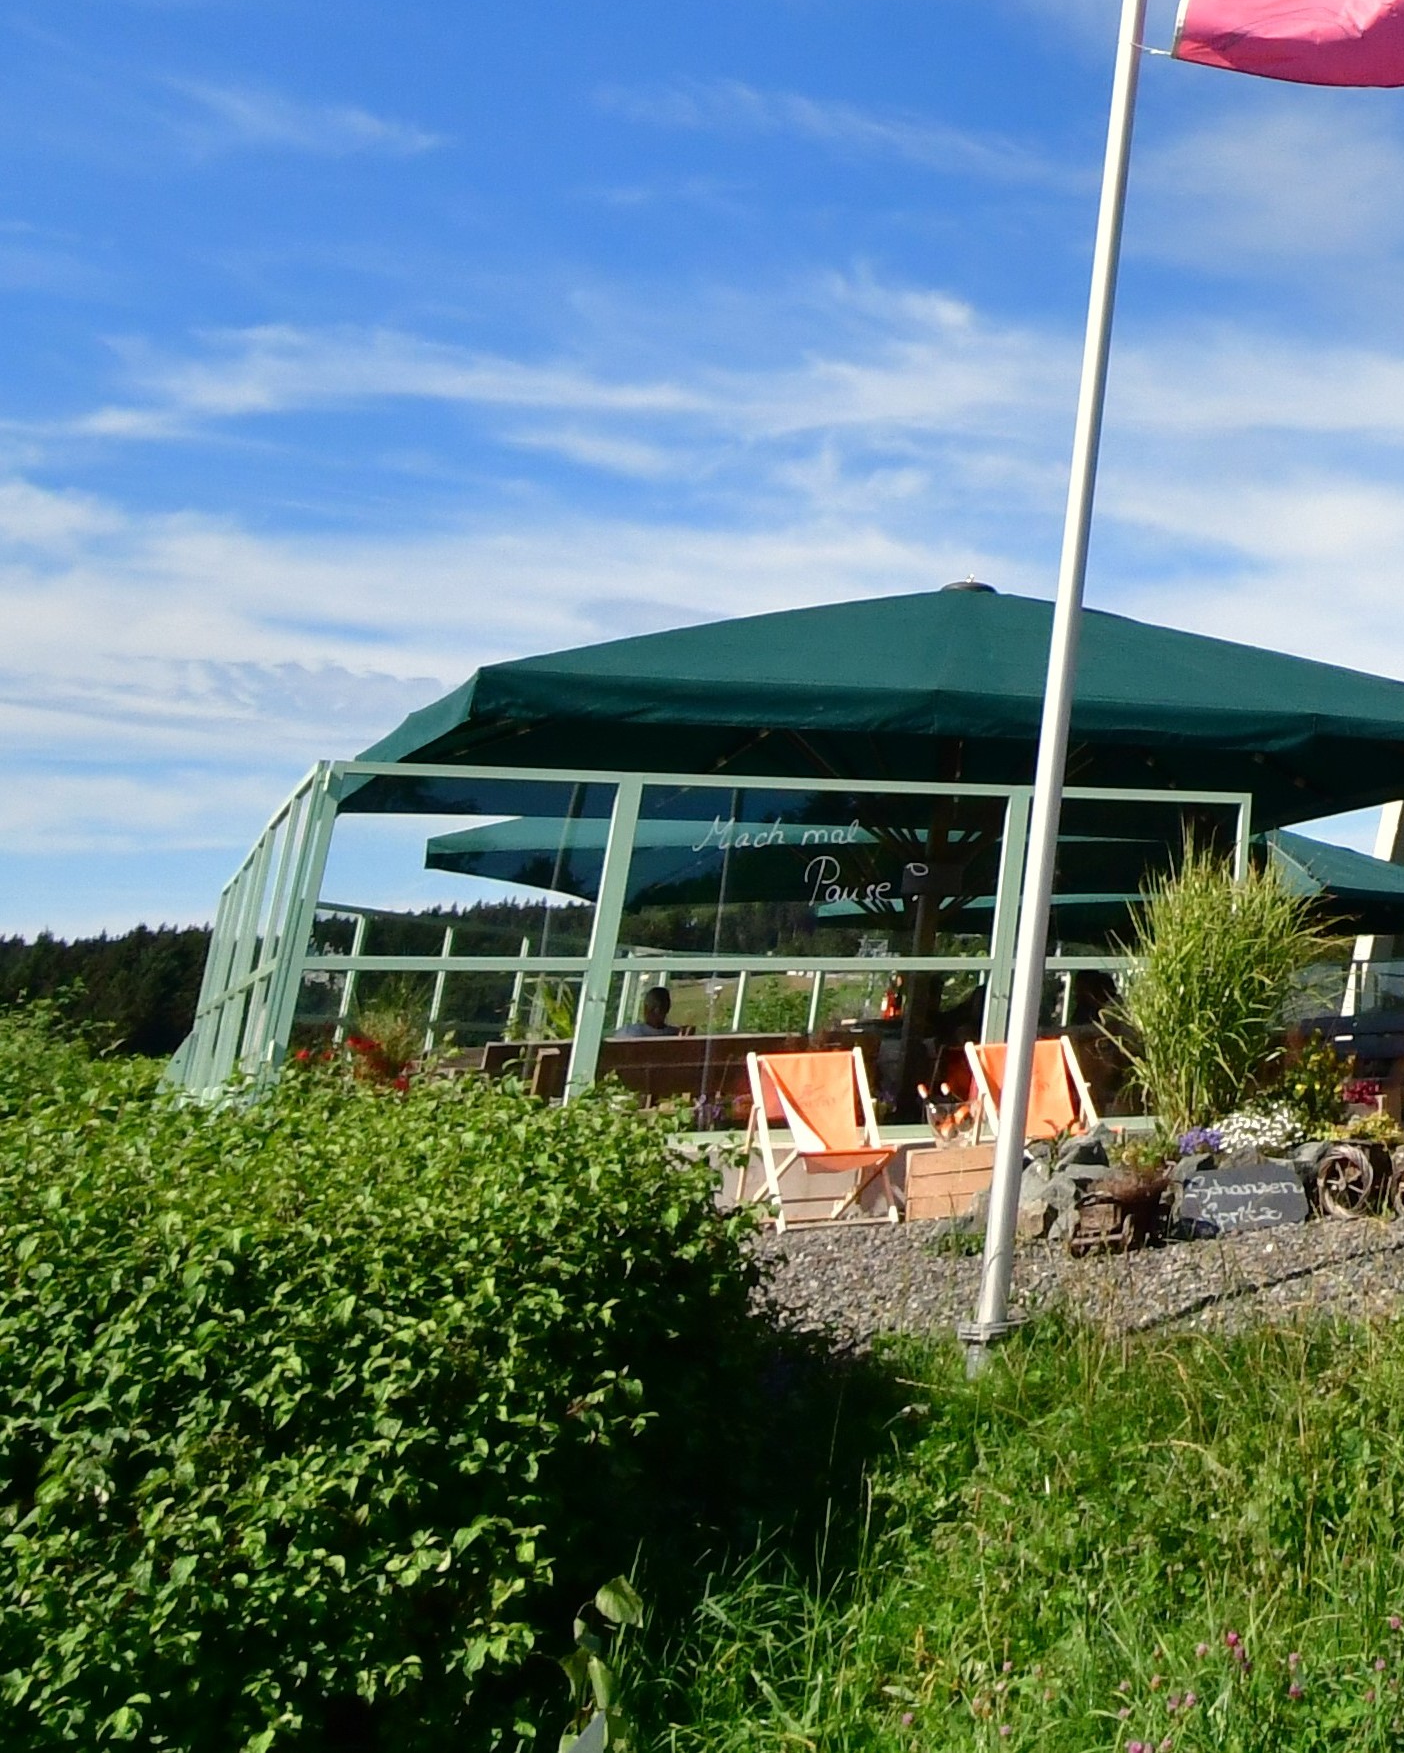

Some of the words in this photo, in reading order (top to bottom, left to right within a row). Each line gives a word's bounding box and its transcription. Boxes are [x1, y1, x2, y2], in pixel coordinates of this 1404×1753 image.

[692, 815, 785, 852] Mach
[801, 818, 859, 847] mal
[1186, 1175, 1304, 1204] Schanzen
